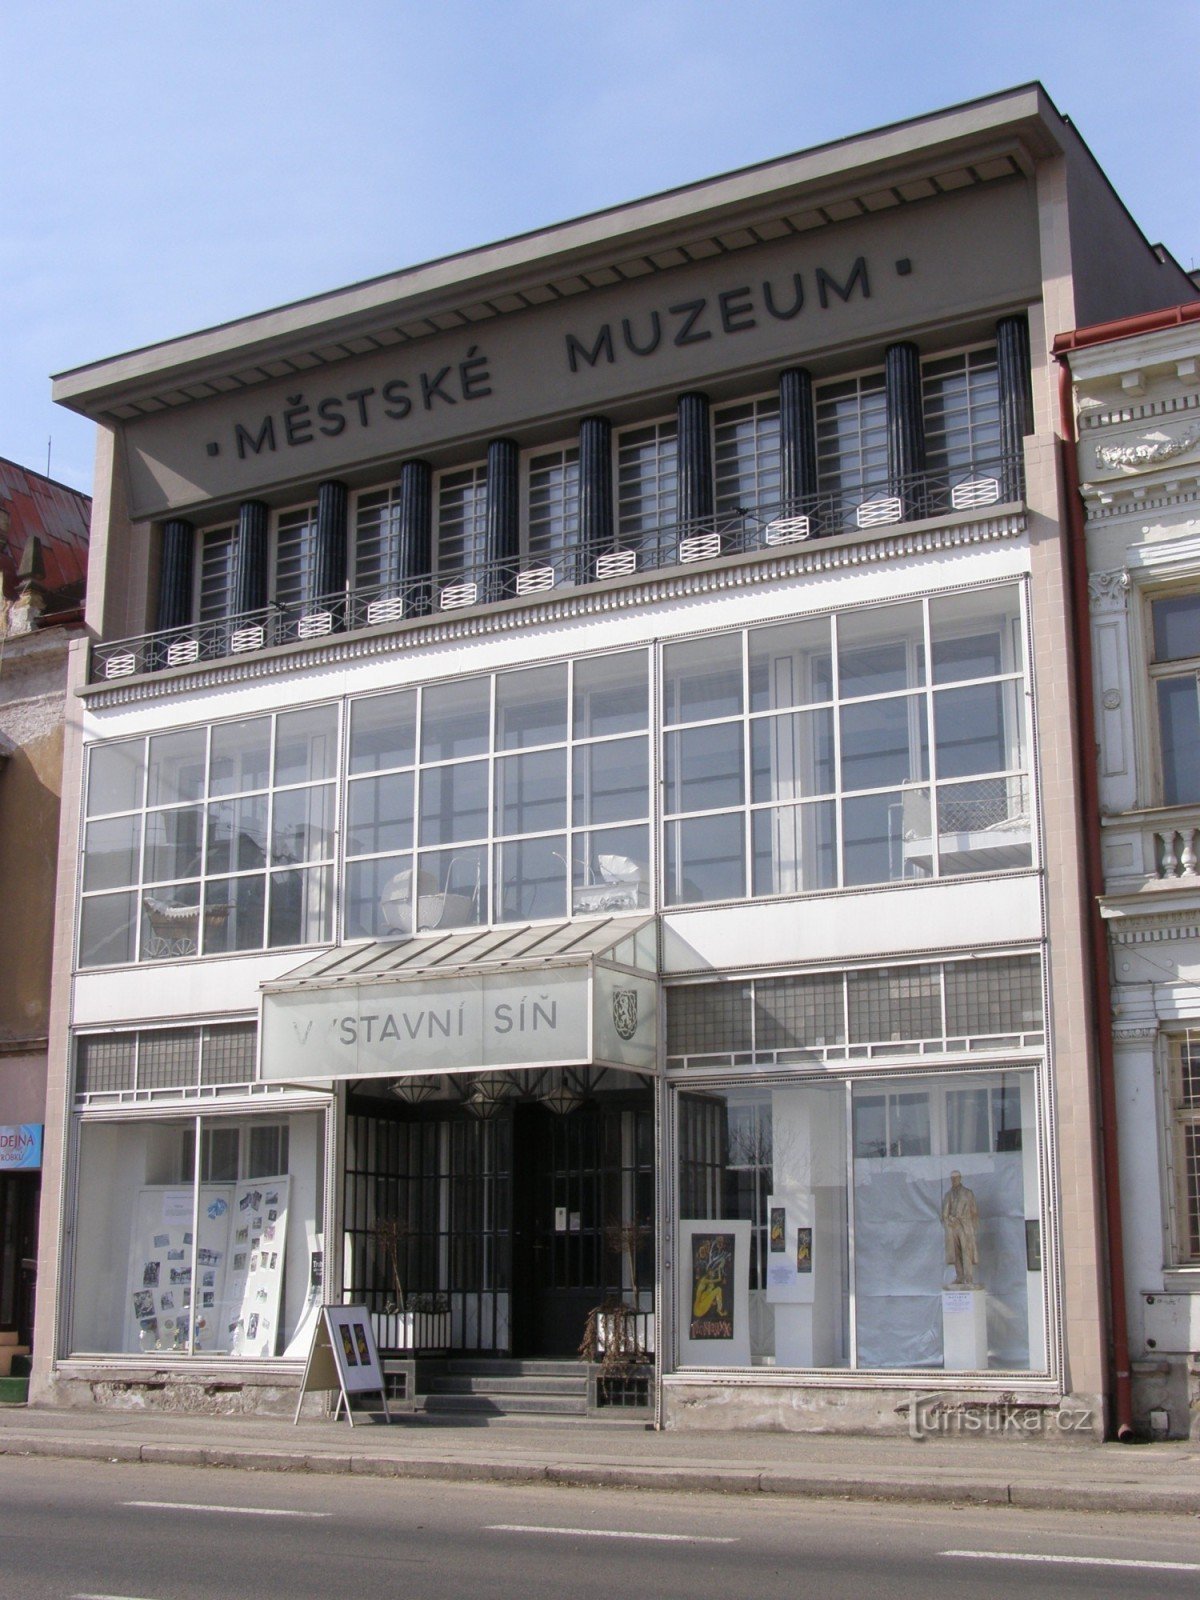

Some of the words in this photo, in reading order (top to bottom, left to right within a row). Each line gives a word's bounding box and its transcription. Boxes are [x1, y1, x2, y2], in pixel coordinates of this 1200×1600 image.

[235, 346, 492, 459] MĚSTSKÉ
[565, 256, 870, 373] MUZEUM
[292, 1001, 465, 1046] VSTAVNÍ
[493, 994, 558, 1034] SÍŇ
